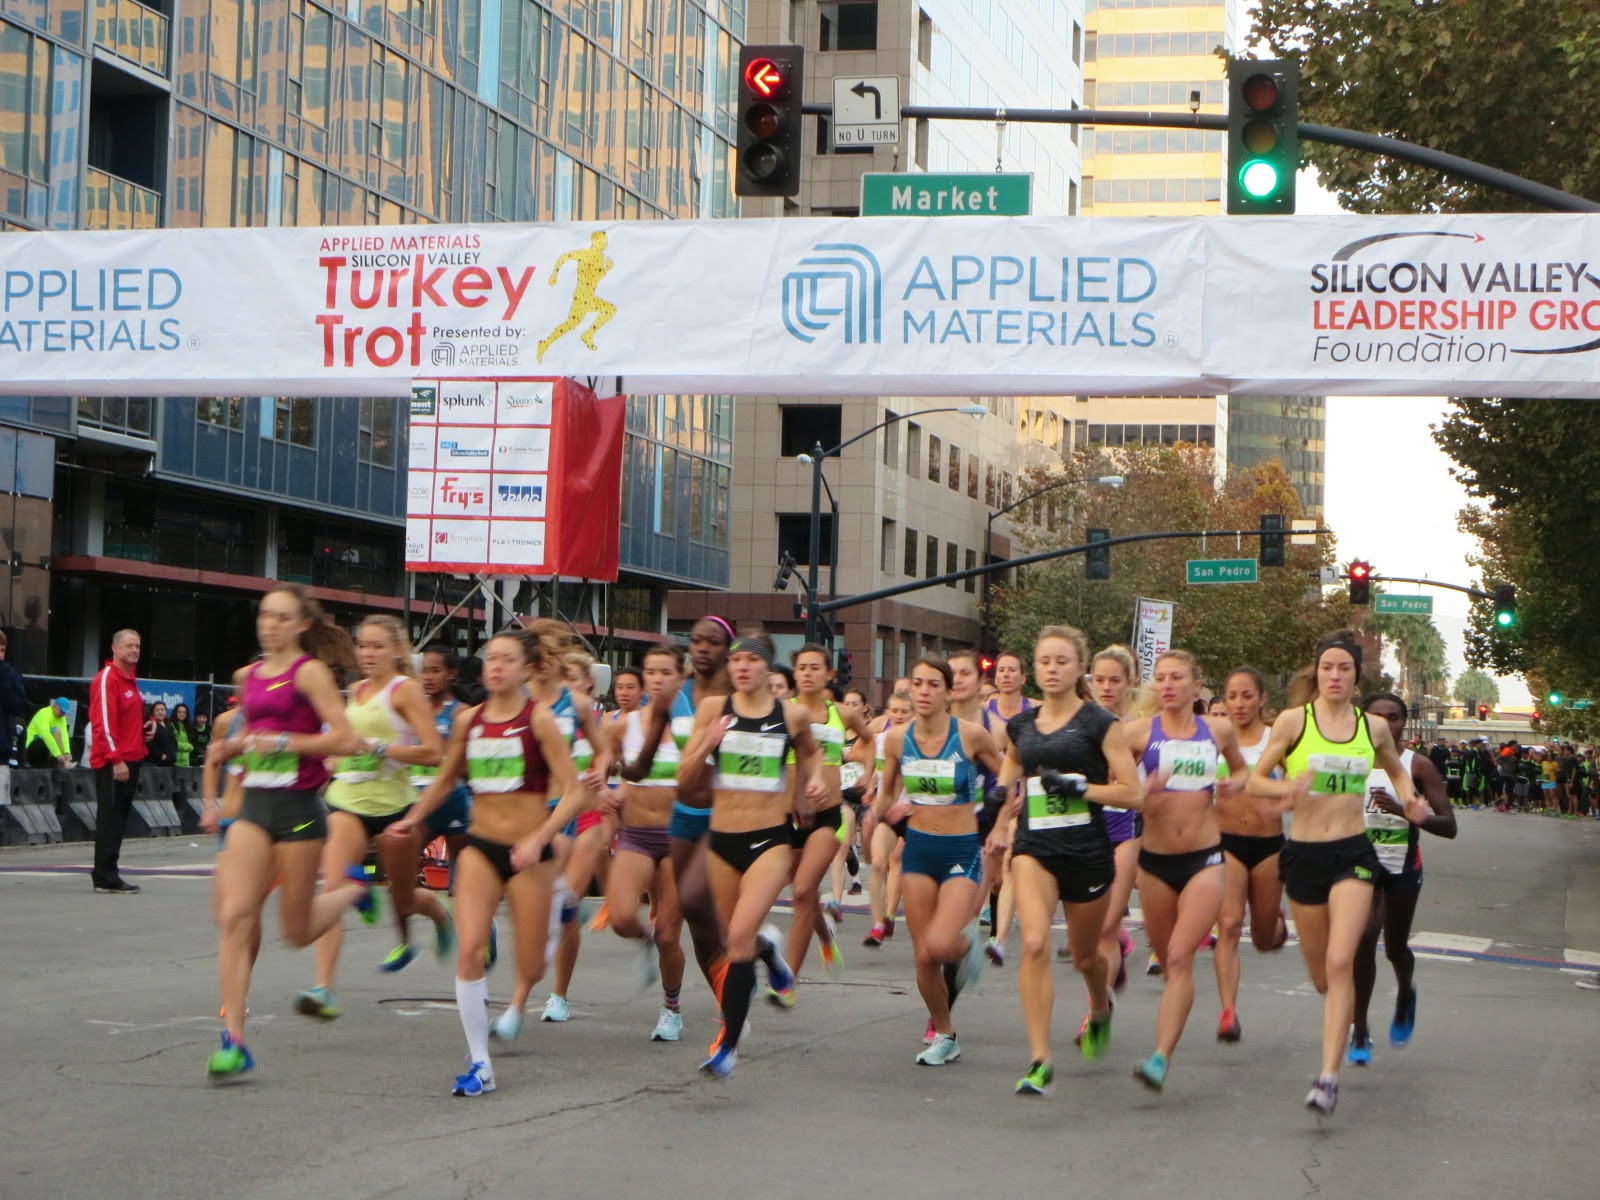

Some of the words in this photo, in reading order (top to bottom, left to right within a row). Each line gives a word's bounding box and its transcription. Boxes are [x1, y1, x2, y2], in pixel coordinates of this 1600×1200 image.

[839, 131, 852, 141] NO
[857, 129, 865, 141] U
[872, 131, 896, 141] TURN
[891, 186, 998, 210] Market
[320, 238, 384, 251] APPLIED
[390, 235, 480, 250] MATERIALS
[352, 255, 410, 267] SILICON
[428, 253, 480, 265] VALLEY
[902, 255, 1157, 303] APPLIED
[1310, 262, 1448, 293] SILICON
[1461, 262, 1588, 293] VALLEY
[319, 254, 536, 320] Turkey
[1313, 299, 1517, 330] LEADERSHIP
[433, 327, 500, 338] Presented
[505, 326, 526, 339] by:
[903, 310, 1156, 347] MATERIALS
[315, 312, 426, 367] Trot
[460, 345, 518, 356] APPLIED
[1313, 335, 1507, 362] Foundation
[459, 357, 518, 366] MATERIALS
[495, 493, 540, 505] KPMG
[1194, 566, 1213, 577] San
[1220, 566, 1250, 577] Pedro
[1381, 600, 1397, 609] San
[1402, 600, 1428, 609] Pedro
[1326, 774, 1346, 792] 41
